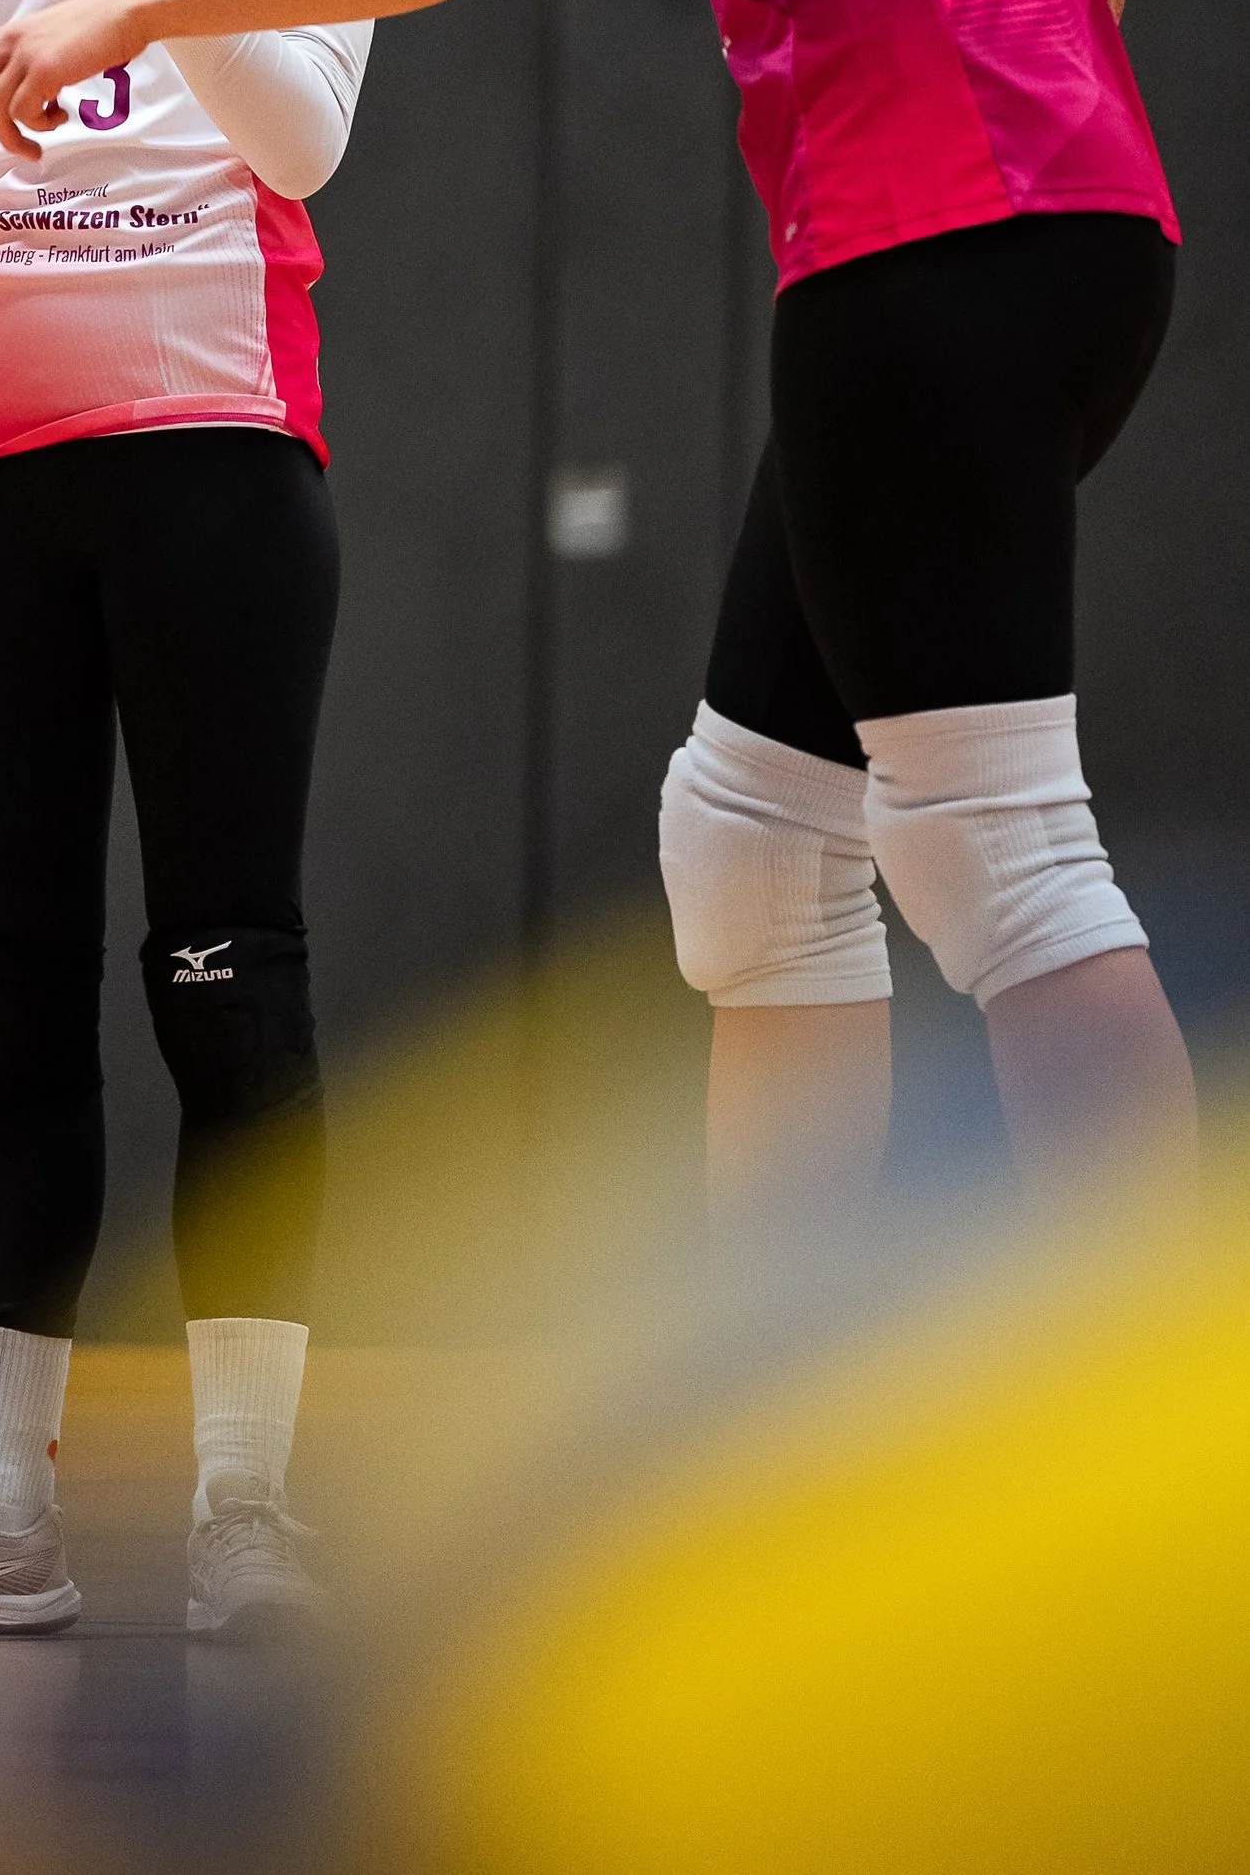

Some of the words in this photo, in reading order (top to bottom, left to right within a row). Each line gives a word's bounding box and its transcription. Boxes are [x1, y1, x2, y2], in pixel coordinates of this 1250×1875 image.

[48, 244, 110, 263] Frankfurt
[114, 248, 136, 263] am
[141, 242, 175, 259] Main
